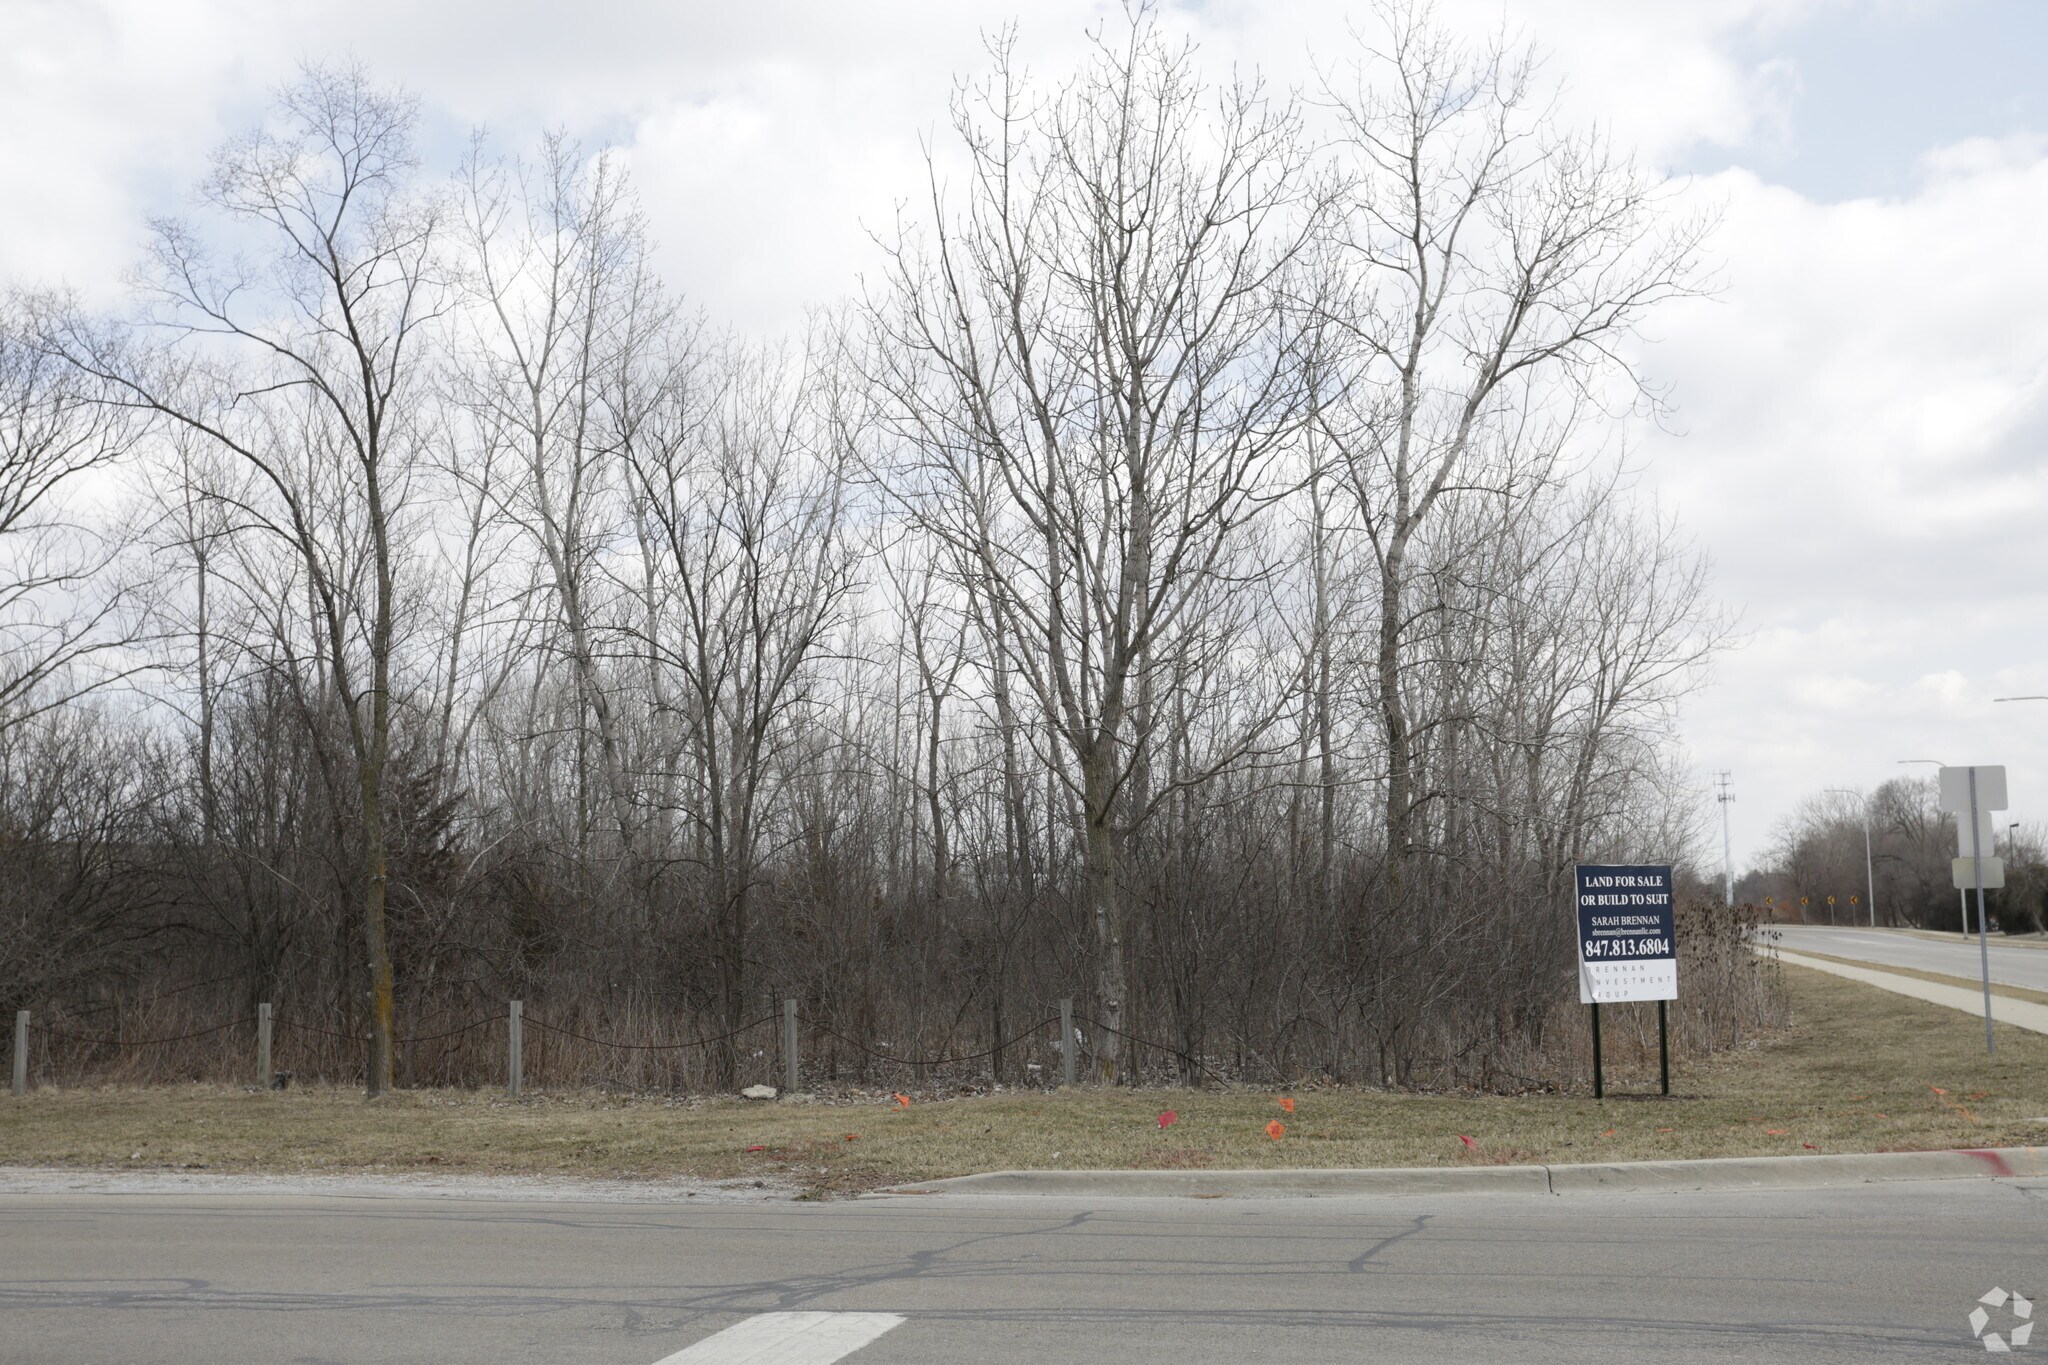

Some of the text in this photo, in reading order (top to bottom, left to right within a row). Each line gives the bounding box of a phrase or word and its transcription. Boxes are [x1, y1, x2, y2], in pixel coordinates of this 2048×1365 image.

[1585, 876, 1663, 887] LAND FOR SALE
[1581, 893, 1669, 906] OR BUILD TO SUIT
[1592, 915, 1660, 926] SARAH BRENNAN
[1585, 938, 1669, 957] 847.813.6804
[1596, 977, 1671, 986] NVESTMENT
[1597, 991, 1629, 999] ROUP
